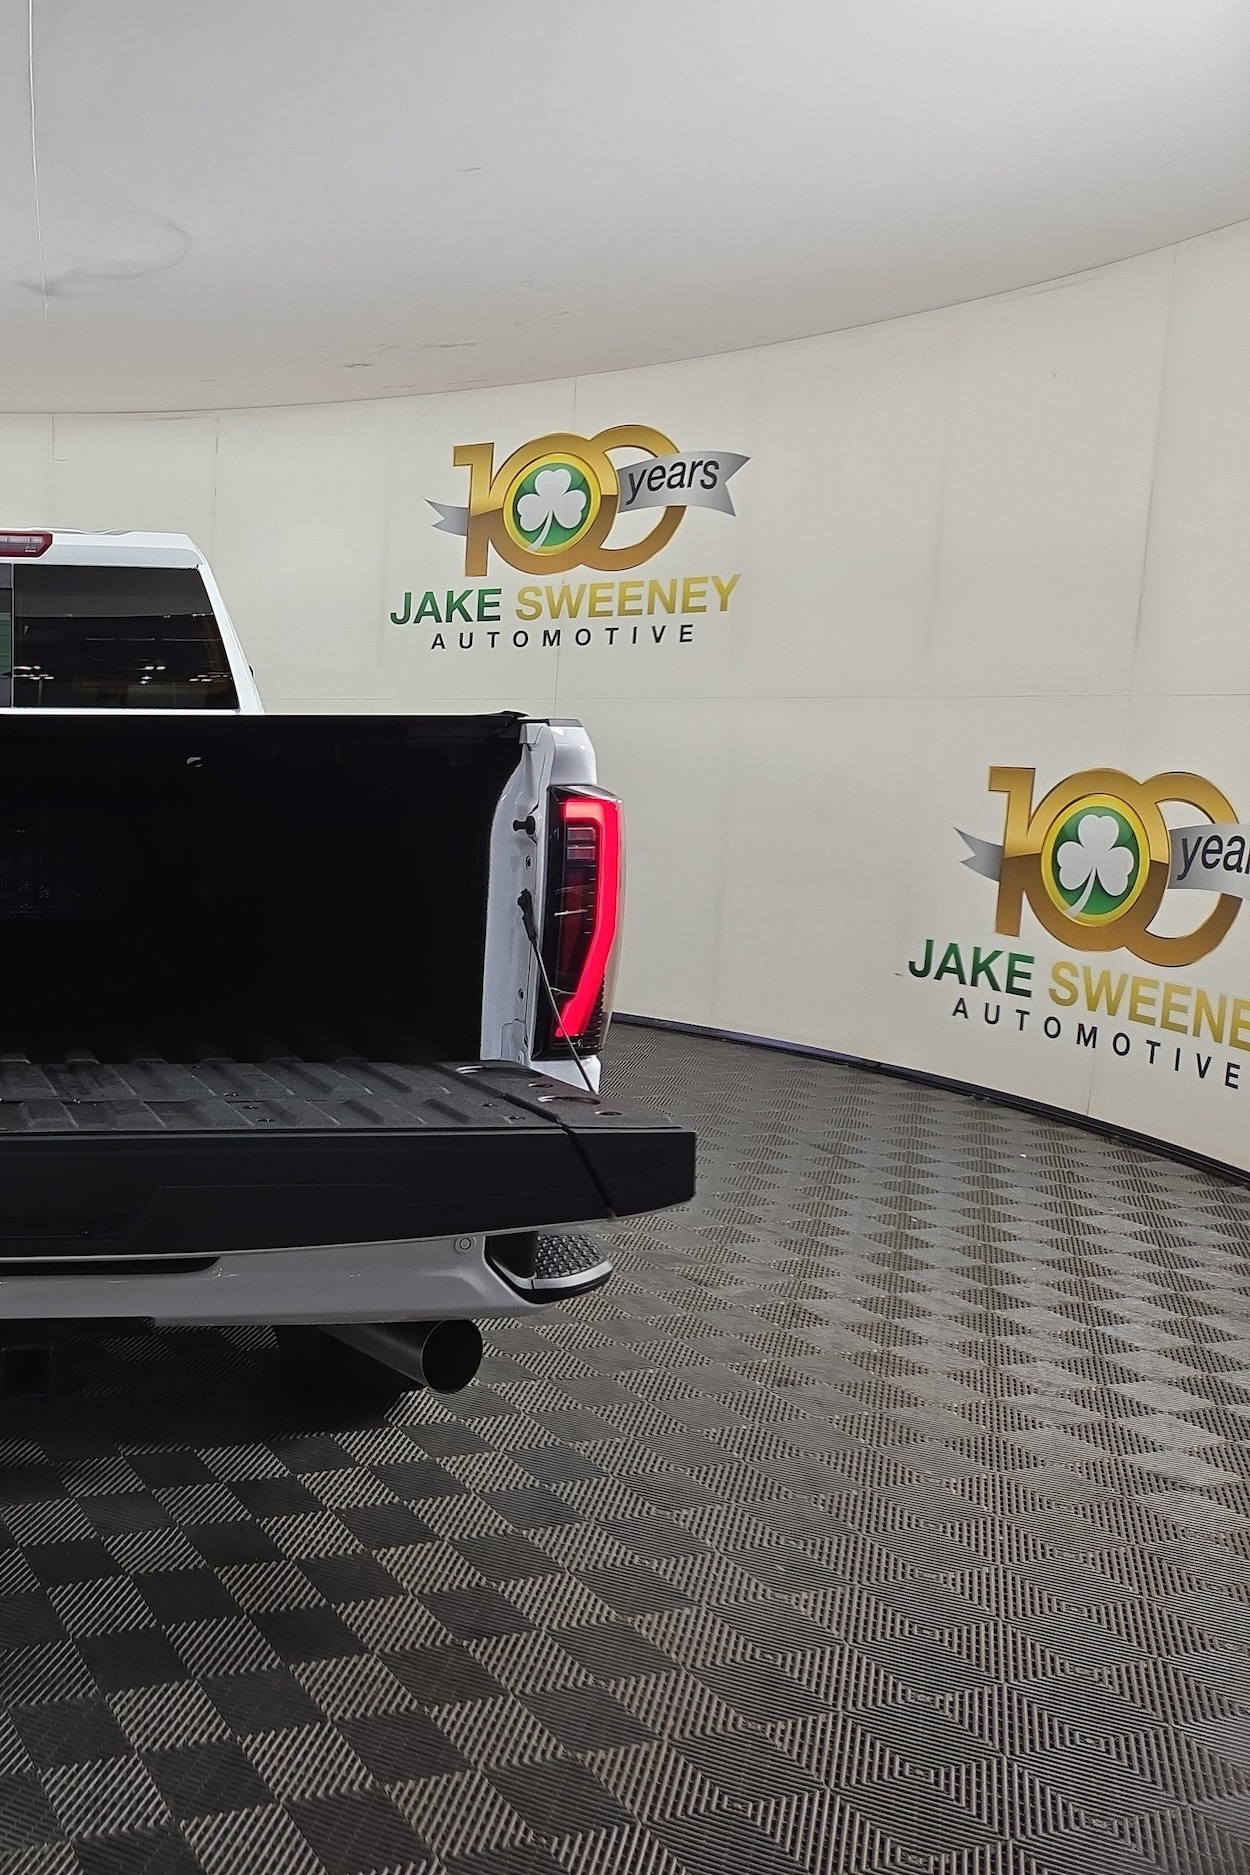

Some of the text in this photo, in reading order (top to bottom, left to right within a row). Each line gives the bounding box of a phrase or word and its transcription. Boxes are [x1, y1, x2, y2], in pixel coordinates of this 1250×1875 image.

[453, 424, 719, 577] 100 years
[390, 574, 742, 625] JAKE SWEENEY
[431, 624, 694, 650] AUTOMOTIVE
[988, 765, 1250, 968] 100 yea
[908, 939, 1250, 1052] JAKE SWEENE
[952, 997, 1241, 1090] AUTOMOTIVE
